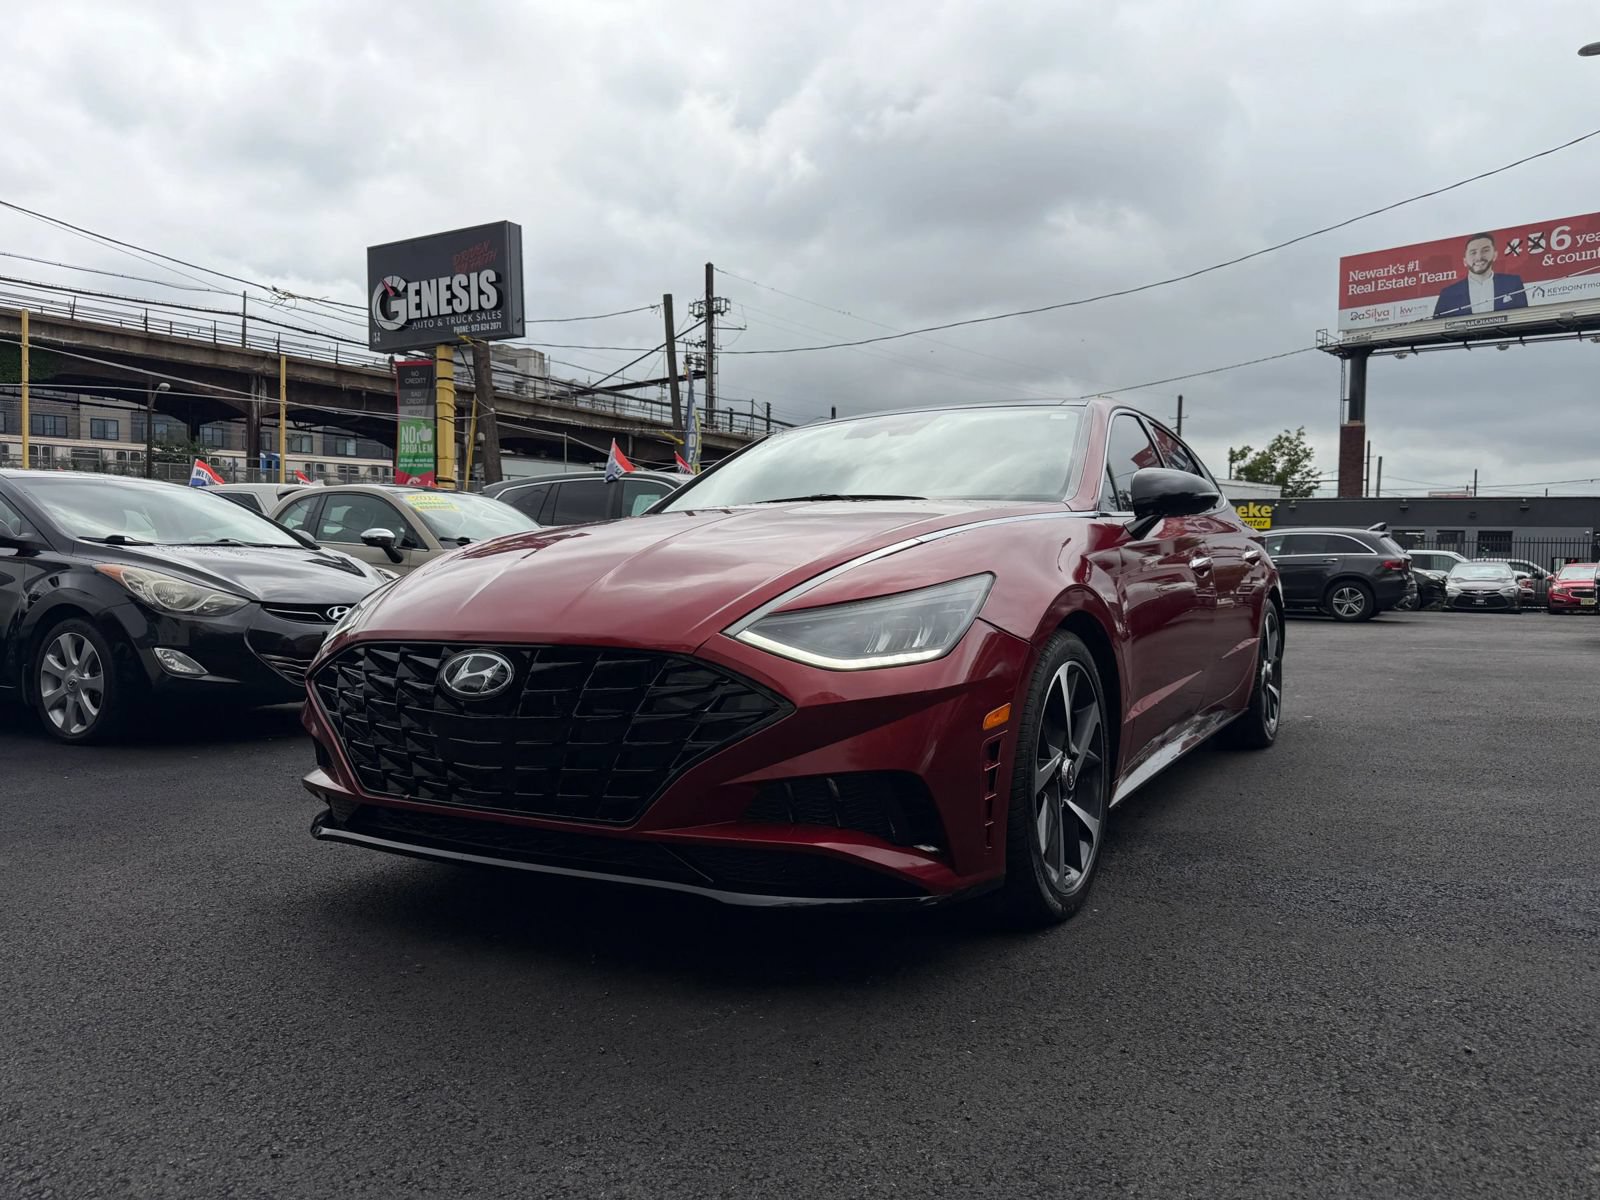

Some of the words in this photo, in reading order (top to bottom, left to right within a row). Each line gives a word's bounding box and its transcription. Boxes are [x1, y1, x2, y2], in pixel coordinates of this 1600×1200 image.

[1550, 225, 1572, 251] 6
[1541, 253, 1555, 267] &
[1349, 263, 1406, 283] Newark's
[1407, 259, 1420, 273] #1
[1348, 280, 1375, 296] Real
[1377, 276, 1417, 291] Estate
[1418, 270, 1457, 284] Team
[371, 269, 498, 331] GENESIS
[412, 319, 435, 330] AUTO
[437, 318, 443, 327] &
[445, 313, 473, 326] TRUCK
[475, 310, 503, 322] SALES
[401, 425, 416, 444] NO
[401, 443, 433, 454] PROBLEM
[1235, 502, 1272, 518] eke
